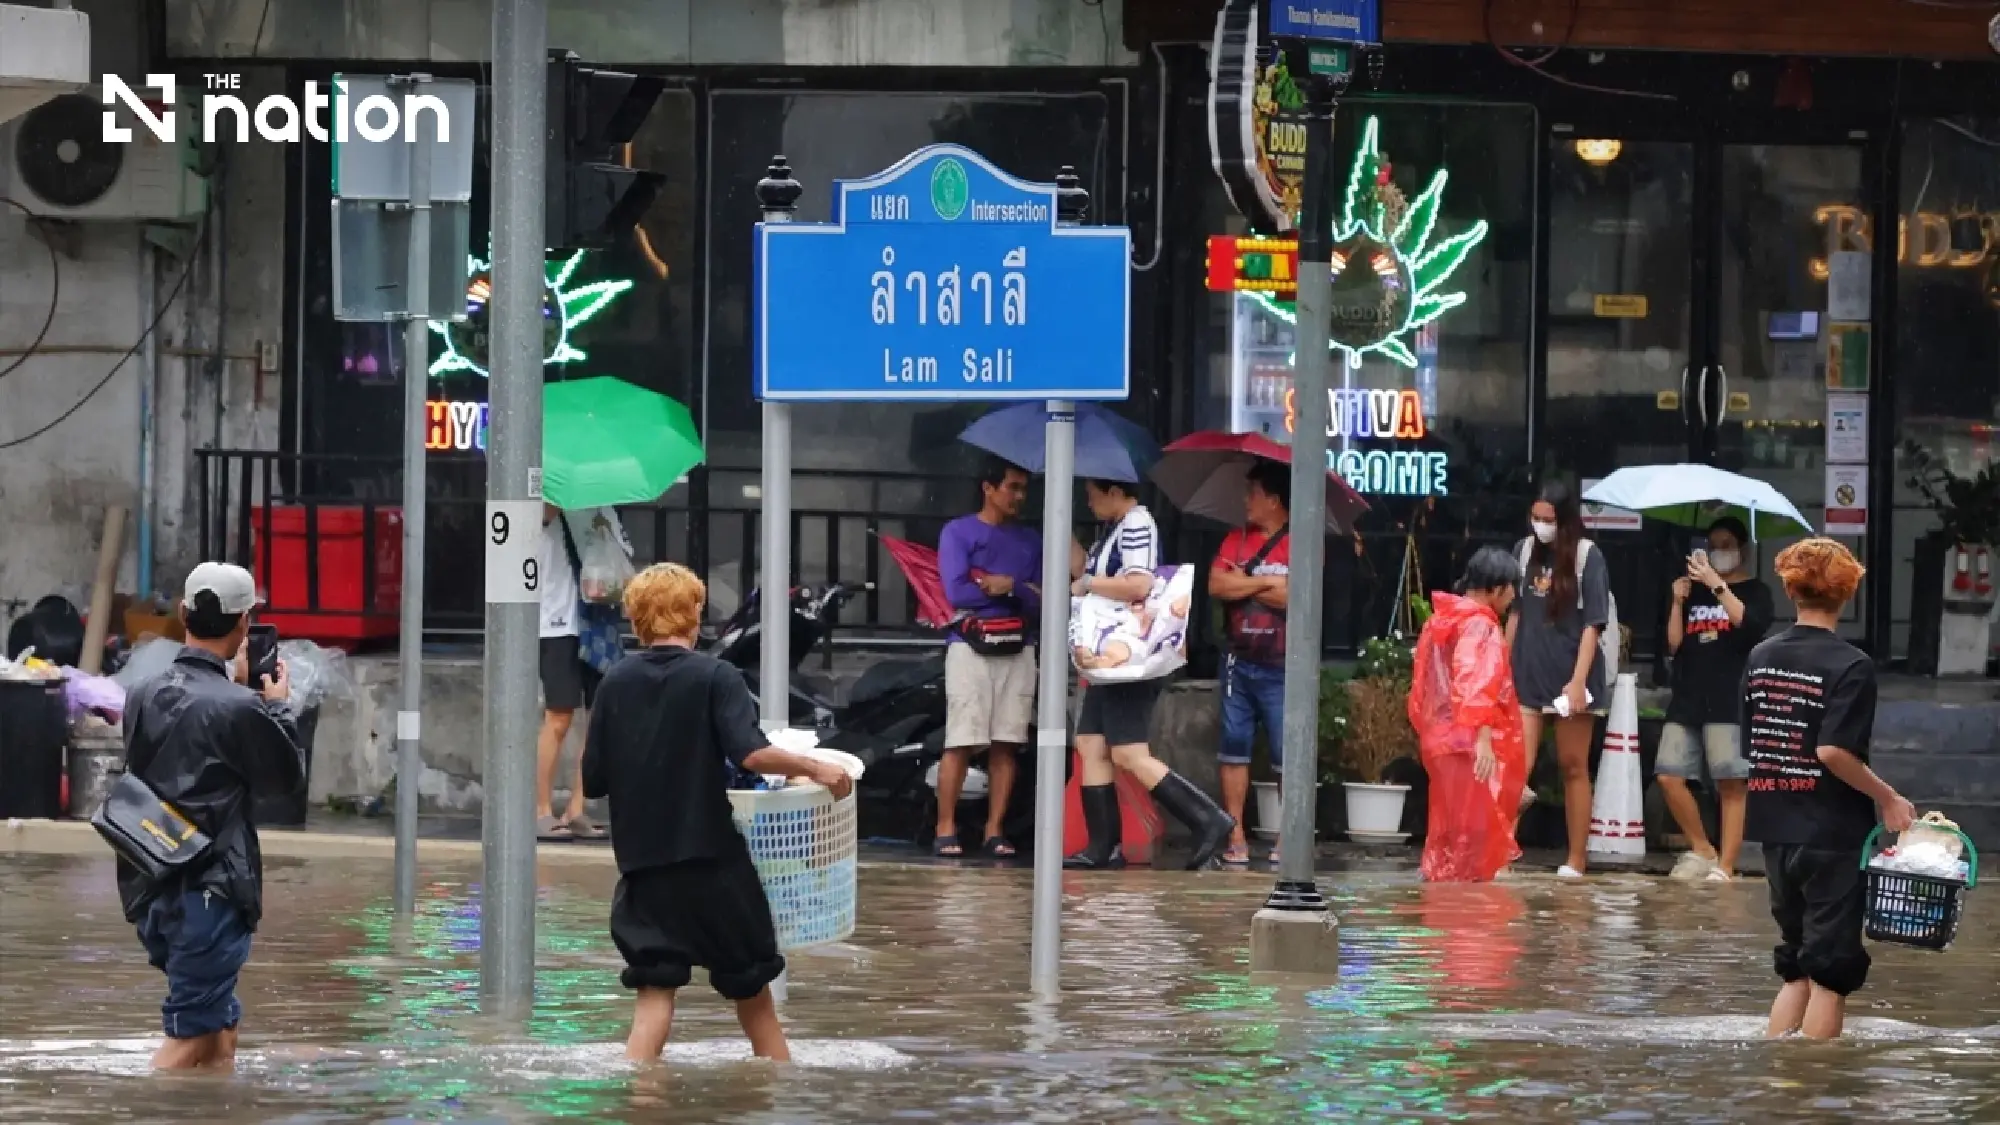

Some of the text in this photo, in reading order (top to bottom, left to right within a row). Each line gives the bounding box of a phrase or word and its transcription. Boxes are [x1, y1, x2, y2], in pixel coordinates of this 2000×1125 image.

[1270, 121, 1307, 153] BUDD
[871, 193, 909, 220] แยก
[971, 199, 1048, 222] Intersection
[871, 245, 1026, 326] ลำสาลี
[884, 348, 1012, 383] Lam Sali
[1326, 449, 1448, 496] COME
[492, 511, 509, 545] 9
[523, 558, 538, 592] 9
